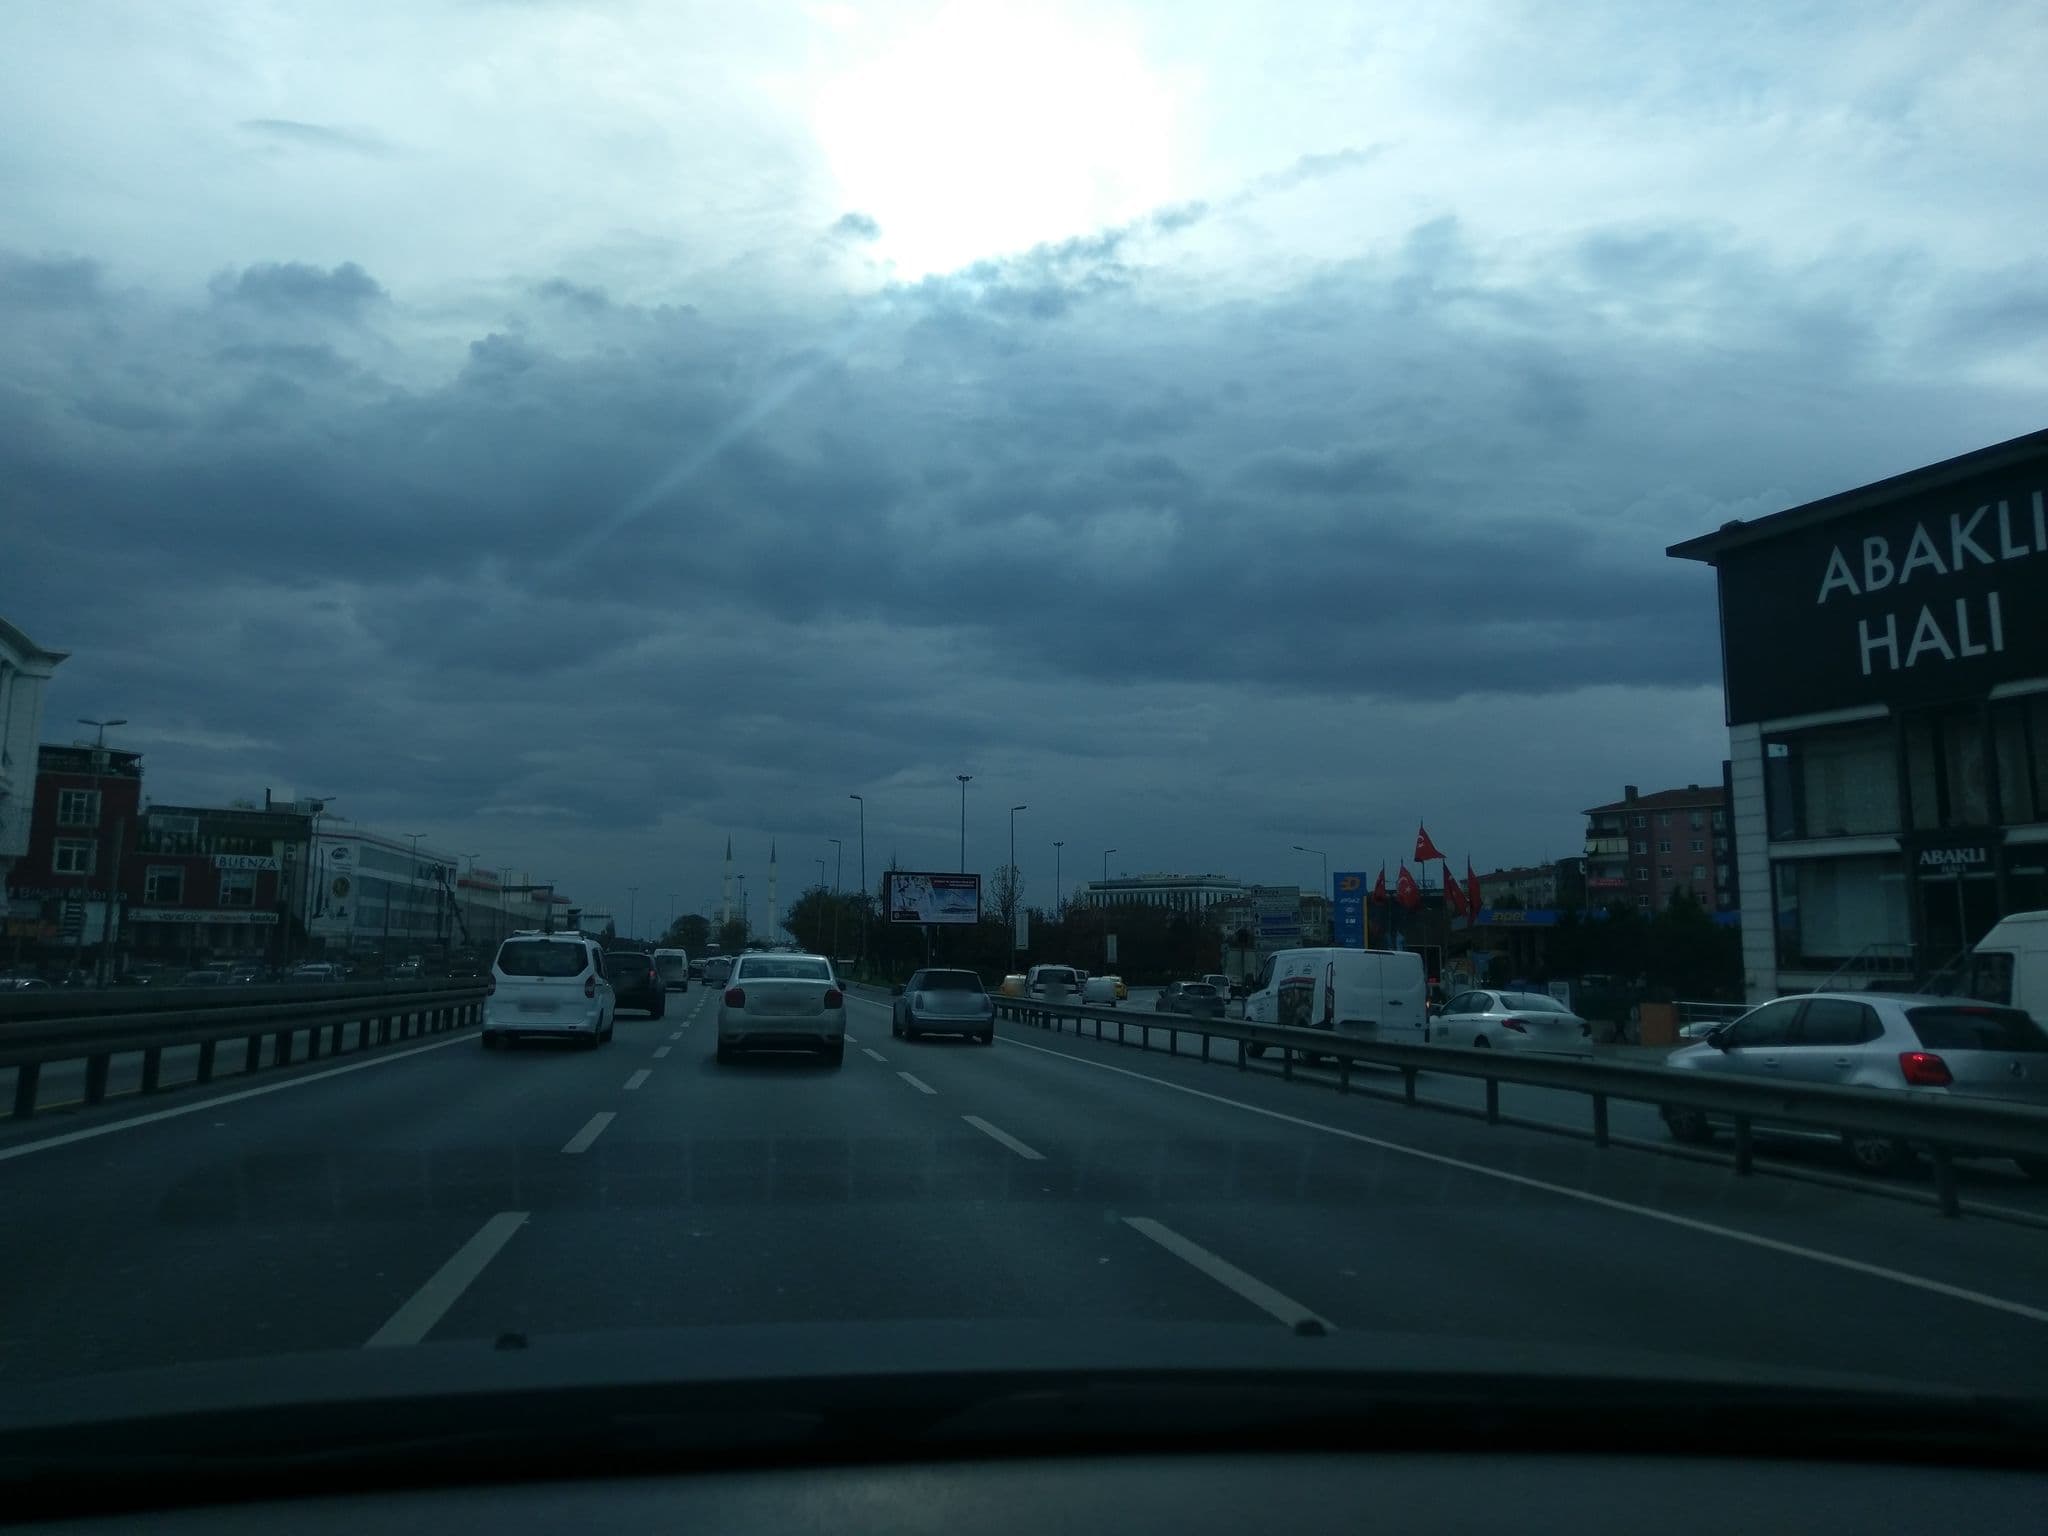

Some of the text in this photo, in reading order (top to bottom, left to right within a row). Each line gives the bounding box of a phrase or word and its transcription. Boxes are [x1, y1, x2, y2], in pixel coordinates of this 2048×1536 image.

[1817, 491, 2047, 604] ABAKLI
[1858, 592, 2004, 675] HALI
[1920, 848, 1986, 865] ABAKLI
